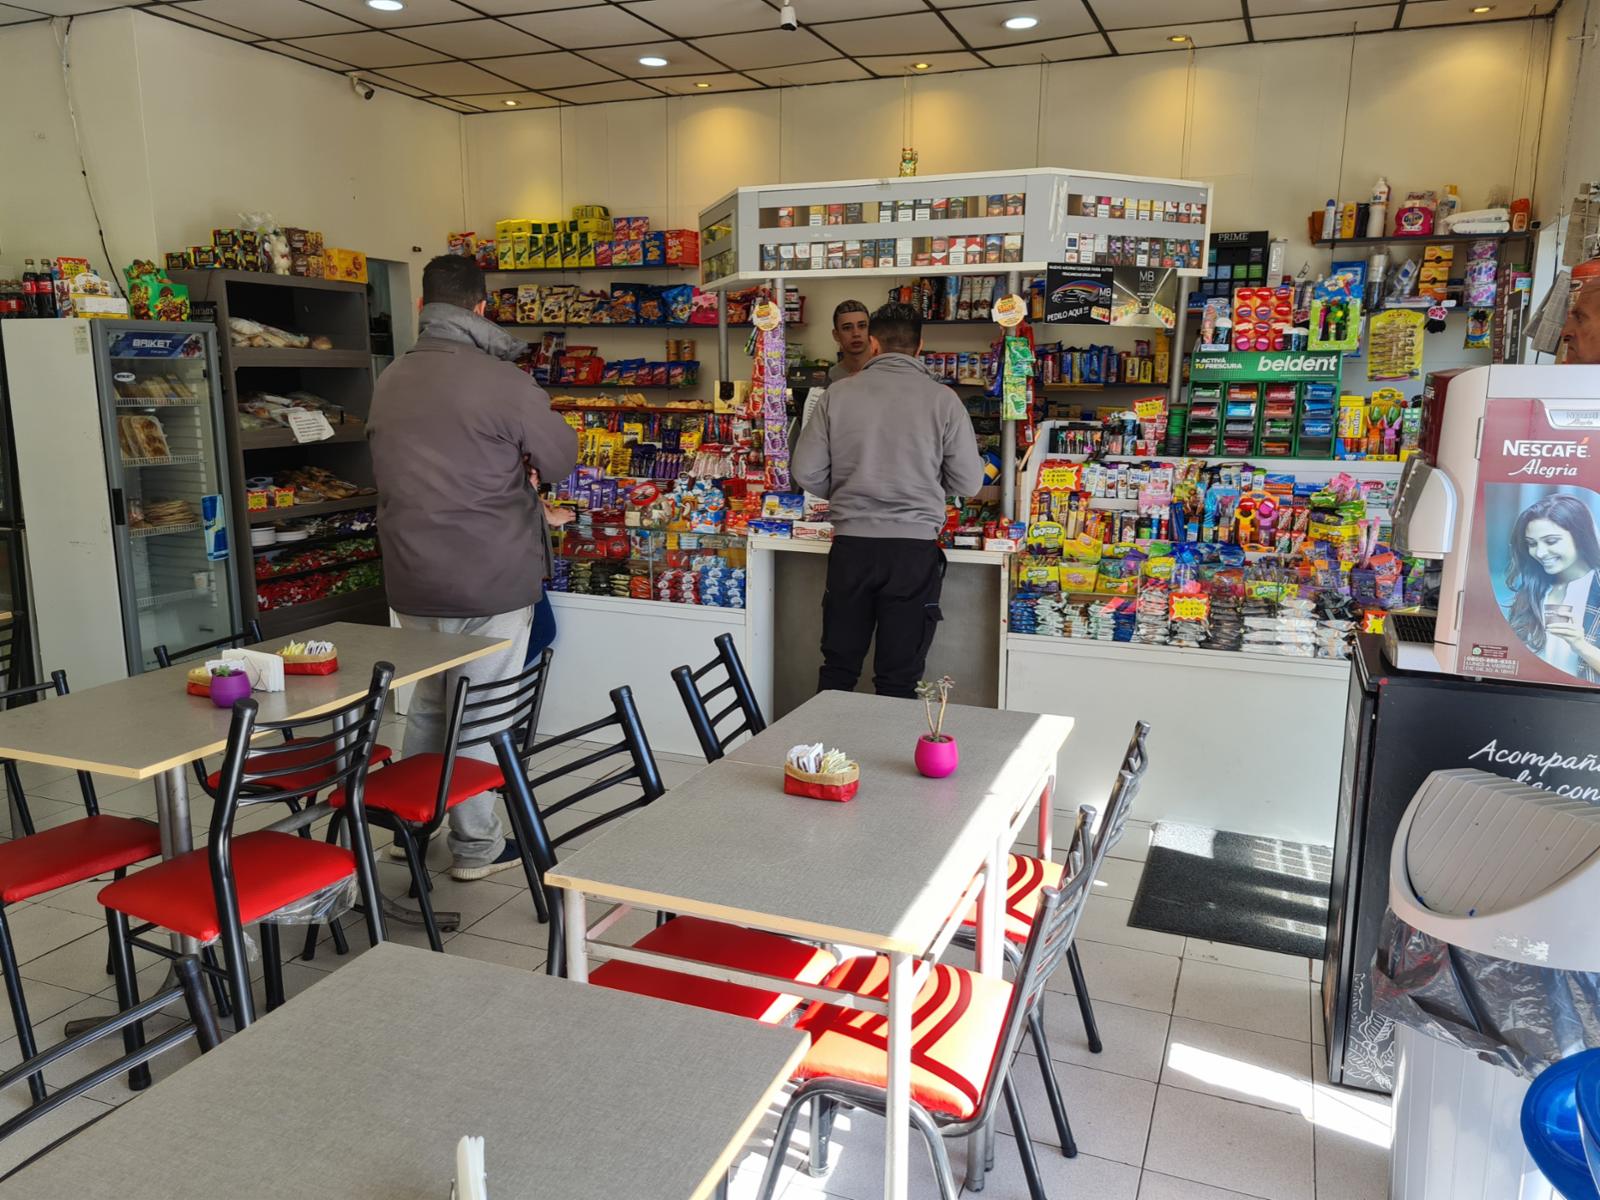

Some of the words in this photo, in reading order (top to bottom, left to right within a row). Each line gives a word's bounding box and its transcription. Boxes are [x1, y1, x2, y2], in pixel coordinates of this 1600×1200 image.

[1218, 232, 1248, 240] PRIME
[1140, 271, 1154, 281] MB
[1100, 287, 1111, 297] MB
[1047, 311, 1068, 322] PEDILO
[1068, 307, 1083, 318] AQUI
[132, 339, 172, 348] BRIKET
[1257, 355, 1338, 372] beldent
[1502, 436, 1589, 458] NESCAFÉ
[1507, 459, 1578, 478] Alegria
[1468, 739, 1600, 776] Acompañ
